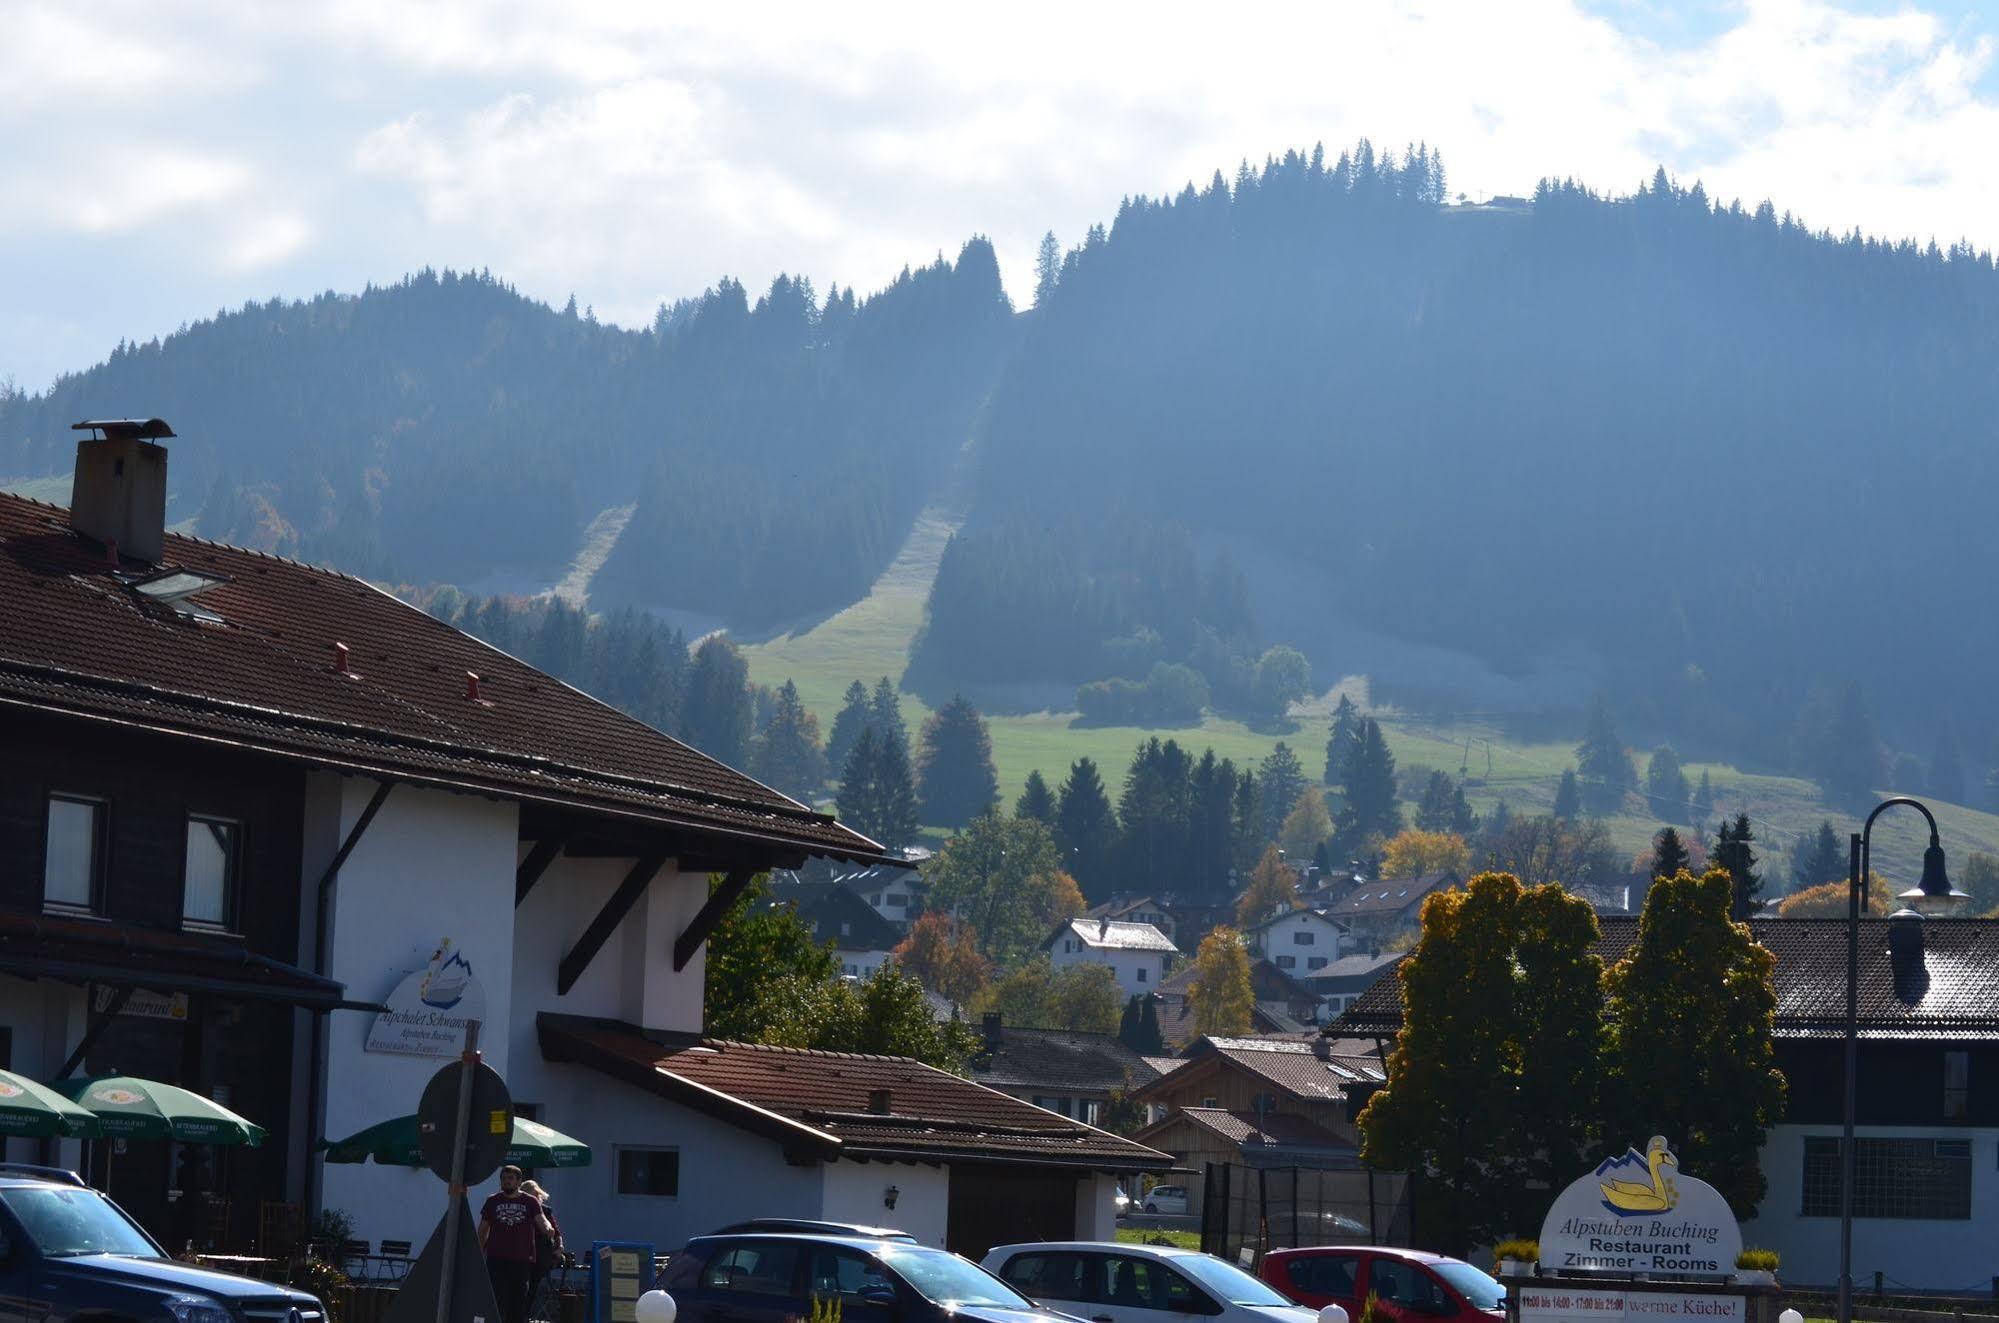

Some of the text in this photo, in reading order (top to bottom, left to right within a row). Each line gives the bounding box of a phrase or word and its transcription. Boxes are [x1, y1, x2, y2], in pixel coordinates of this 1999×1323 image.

[1559, 1217, 1719, 1244] Alpstuben Buching
[1590, 1238, 1691, 1254] Restaurant
[1564, 1253, 1634, 1268] Zimmer
[1652, 1256, 1718, 1271] Rooms
[1522, 1296, 1540, 1308] 11:00
[1541, 1296, 1551, 1308] bis
[1575, 1297, 1593, 1309] 17:00
[1594, 1298, 1604, 1310] bis
[1629, 1299, 1736, 1316] warme Küche!
